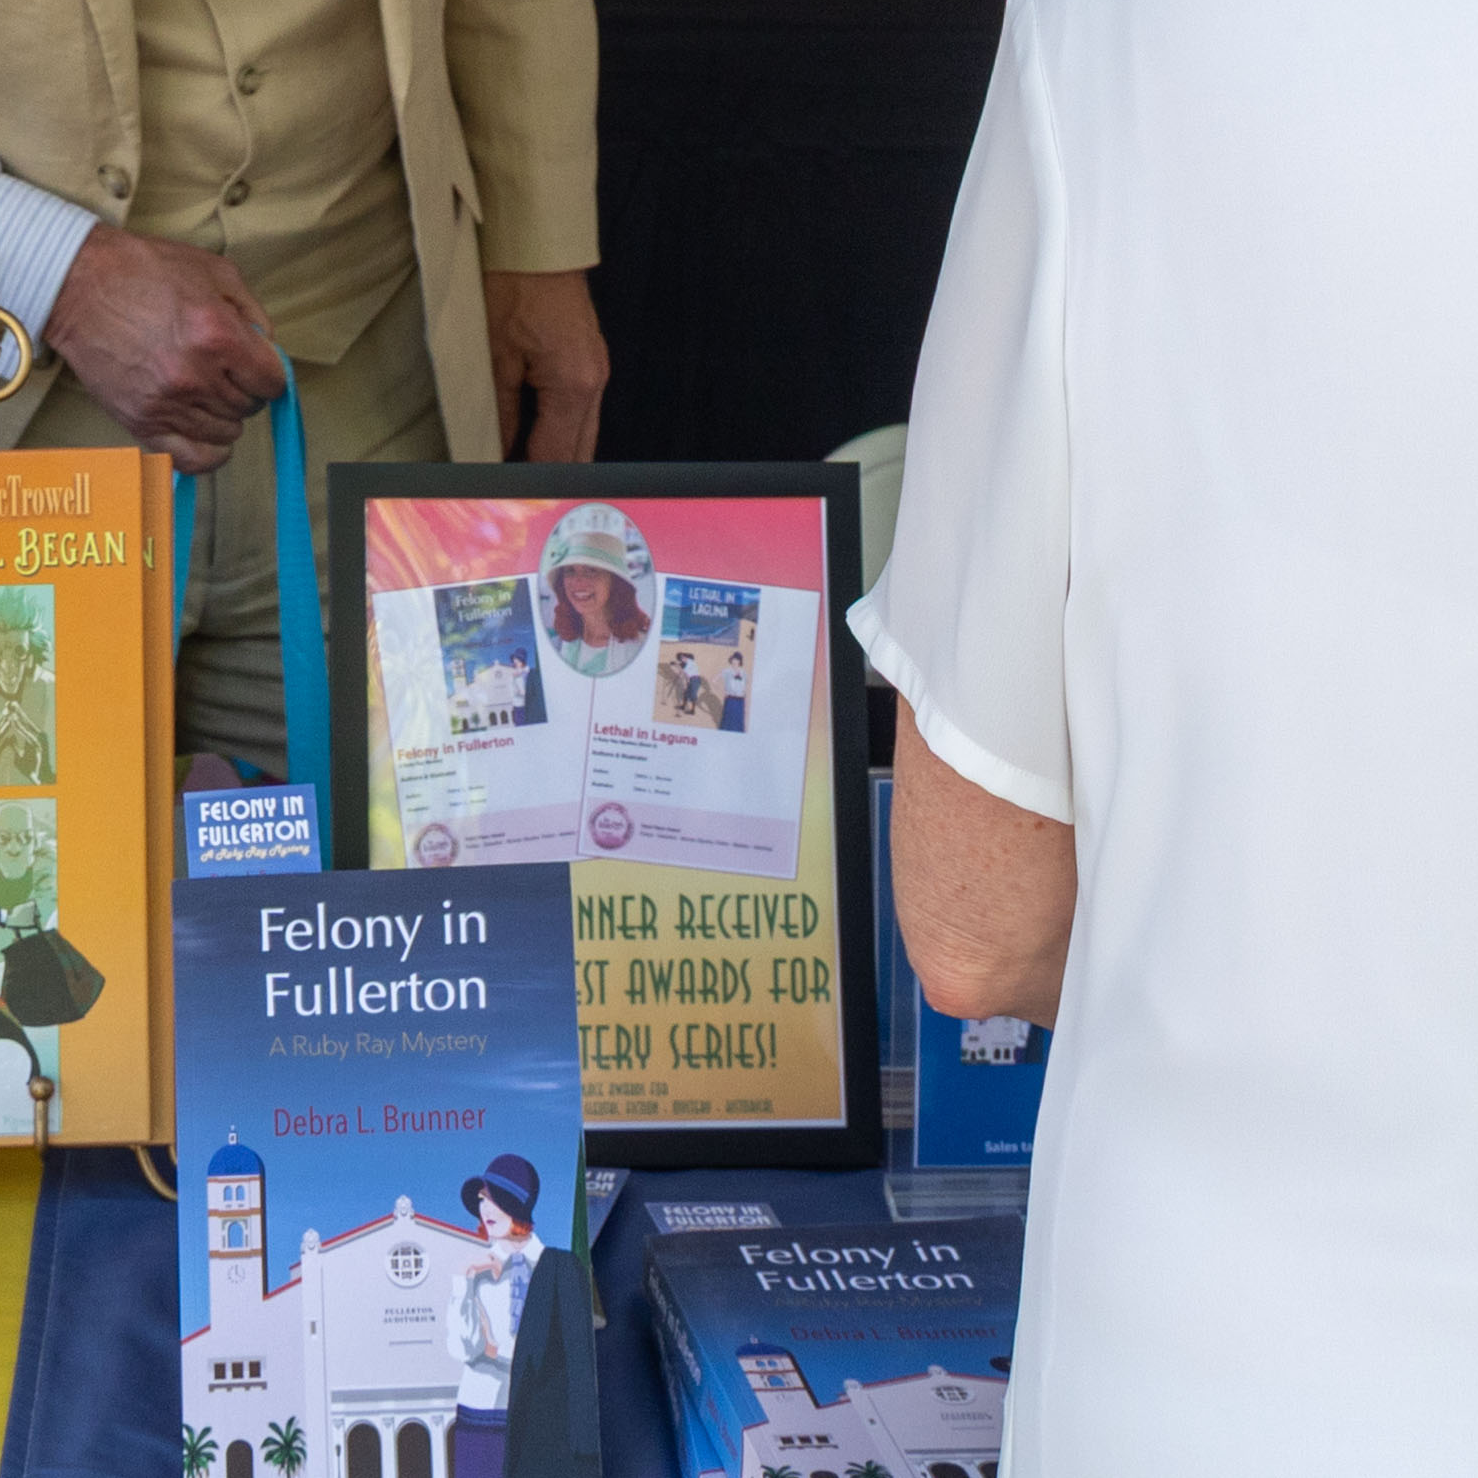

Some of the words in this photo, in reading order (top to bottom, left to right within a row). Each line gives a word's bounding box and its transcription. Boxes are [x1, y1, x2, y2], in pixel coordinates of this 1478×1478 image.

[14, 526, 127, 576] BEGAN
[397, 745, 440, 762] Felony
[442, 741, 455, 756] in
[457, 735, 515, 755] Fullerton
[594, 722, 635, 738] Lethal
[636, 727, 649, 740] in
[651, 729, 699, 747] Laguna
[199, 797, 277, 823] FELONY
[282, 794, 305, 816] IN
[197, 819, 310, 848] FULLERTON
[260, 901, 423, 963] Felony
[442, 899, 487, 946] in
[577, 893, 659, 941] NNER
[674, 892, 820, 941] RECEIVED
[265, 965, 487, 1018] Fullerton
[625, 957, 752, 1006] AWARDS
[768, 956, 831, 1005] FOR
[269, 1036, 287, 1057] A
[292, 1033, 350, 1061] Ruby
[355, 1032, 396, 1059] Ray
[401, 1031, 488, 1058] Mystery
[578, 1023, 653, 1071] TERY
[670, 1021, 778, 1071] SERIES!
[273, 1105, 349, 1137] Debra
[357, 1105, 375, 1135] L.
[382, 1104, 487, 1133] Brunner
[984, 1140, 1017, 1154] Sales
[662, 1205, 736, 1217] FELONY
[740, 1205, 763, 1216] IN
[664, 1215, 772, 1227] FULLERTON
[738, 1242, 898, 1270] Felony
[911, 1239, 962, 1264] in
[755, 1267, 976, 1293] Fullerton
[789, 1325, 867, 1342] Debra
[896, 1324, 999, 1340] Brunner
